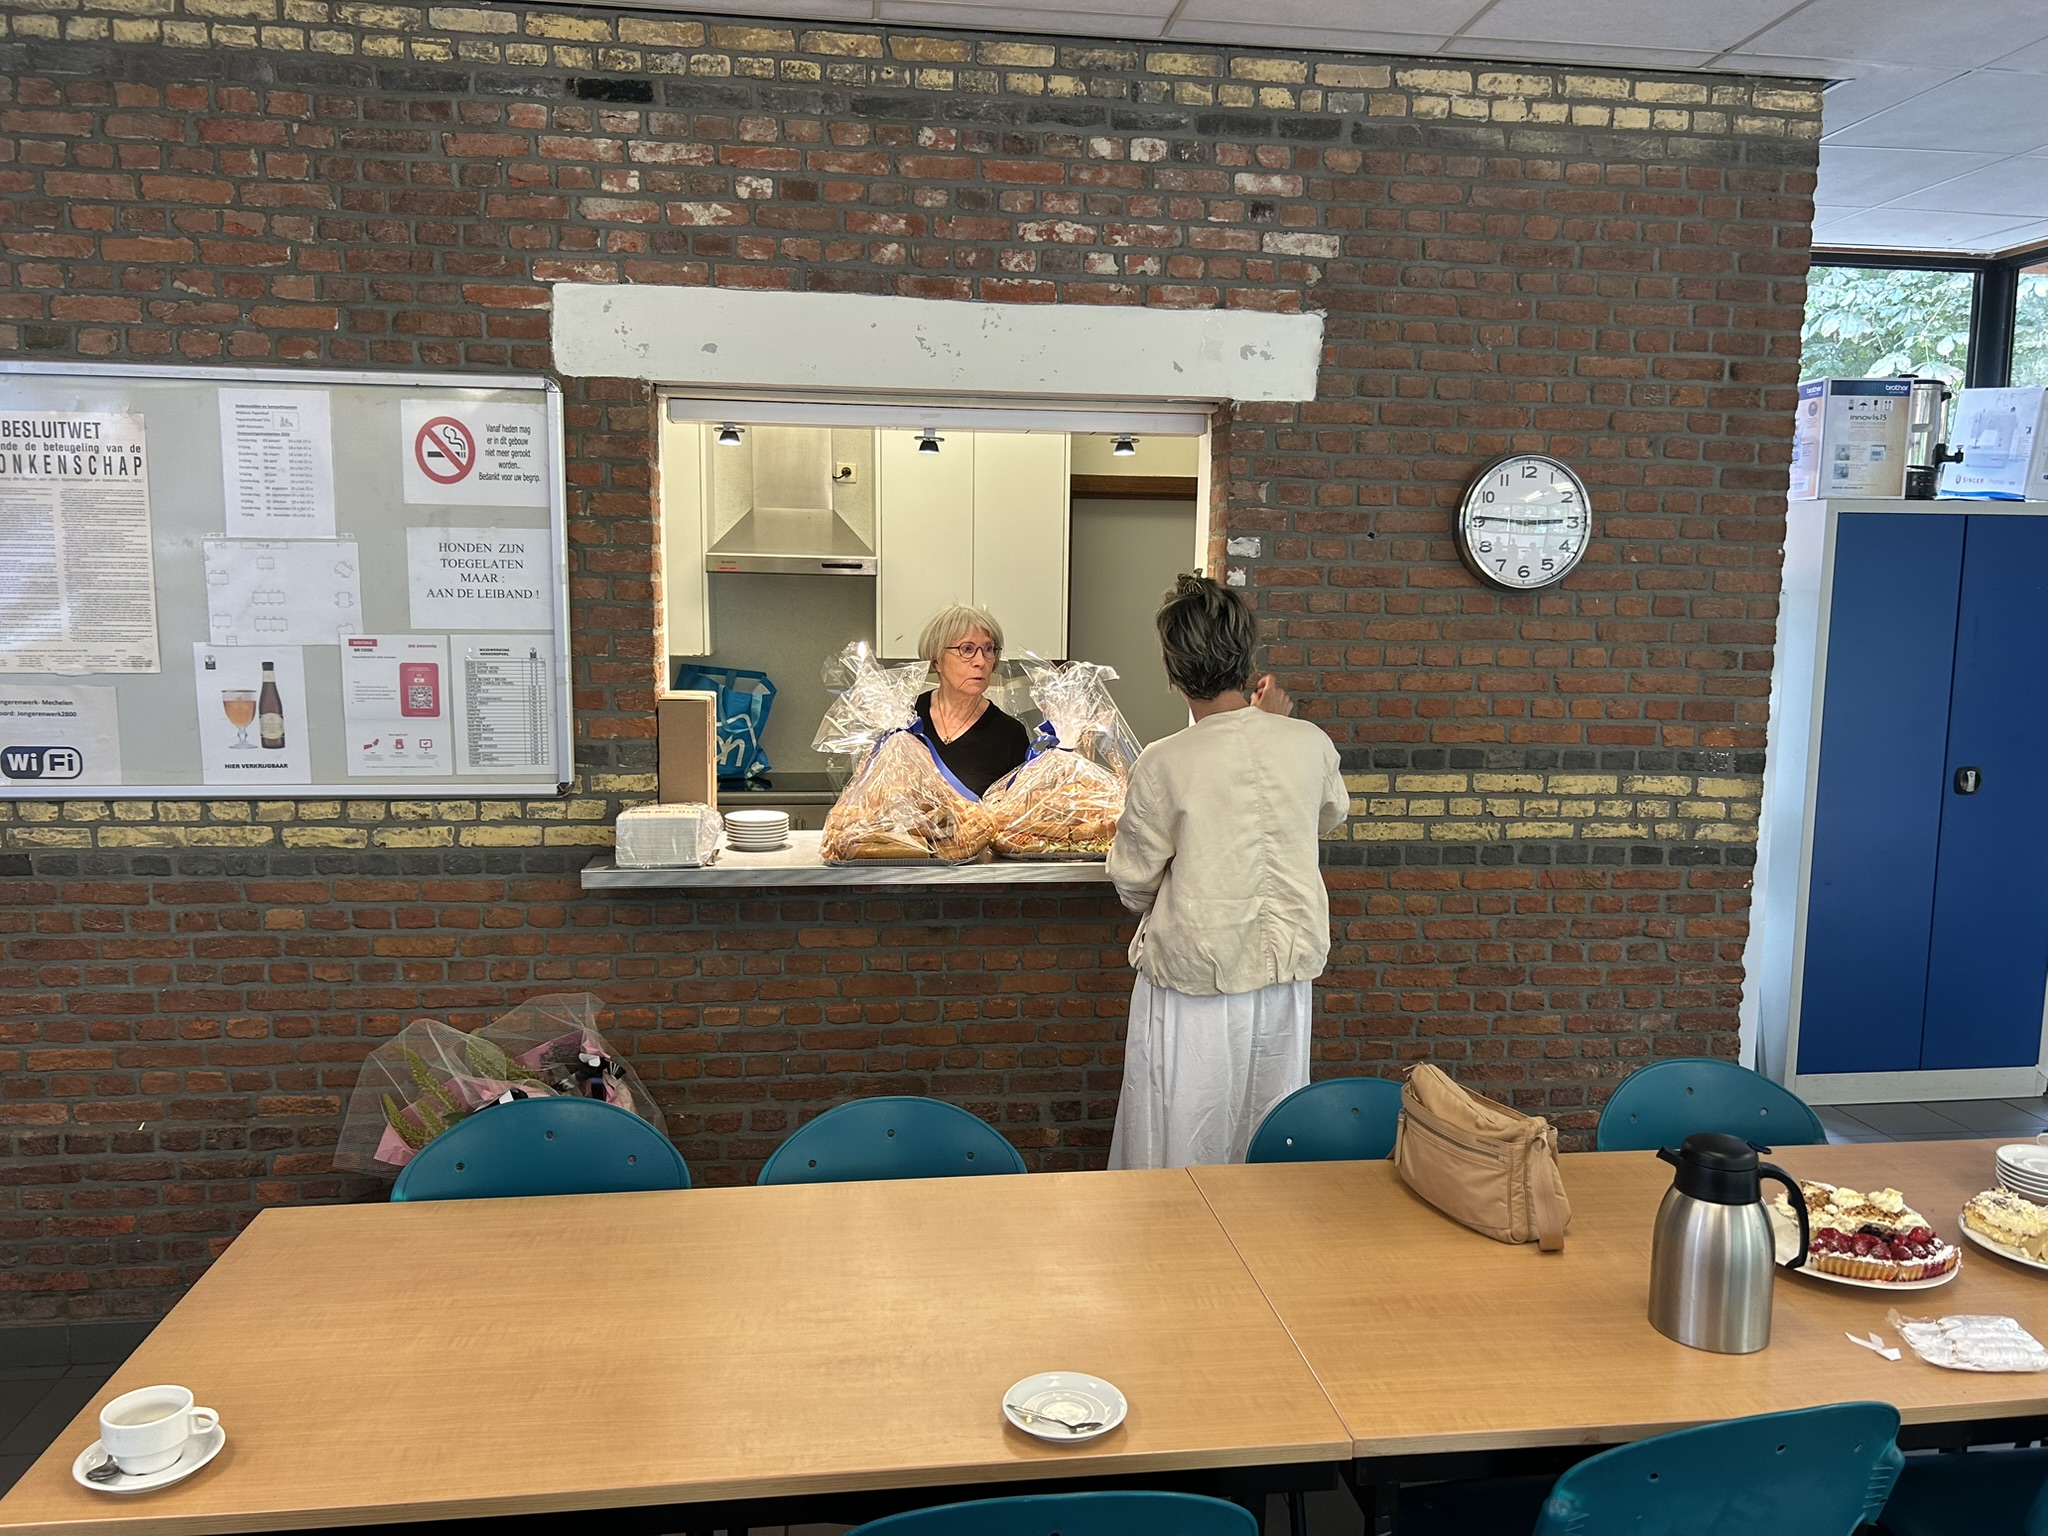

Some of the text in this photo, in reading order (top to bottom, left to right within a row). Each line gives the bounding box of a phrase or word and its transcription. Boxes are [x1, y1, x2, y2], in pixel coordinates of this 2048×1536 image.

[1806, 385, 1822, 394] brother
[1886, 384, 1909, 392] brother
[2, 420, 101, 439] BESLUITWET
[486, 424, 531, 435] Vanaf heden mag
[494, 436, 499, 445] in
[500, 436, 508, 445] dit
[508, 437, 529, 447] gebouw
[0, 442, 141, 454] nde de beteugeling van de
[485, 448, 531, 459] niet meer gerookt
[0, 454, 142, 476] ONKENSCHAP
[479, 472, 500, 481] Bedankt
[523, 474, 541, 484] begrip.
[1521, 466, 1537, 478] 12
[1550, 472, 1554, 484] 1
[1500, 474, 1509, 486] 11
[1482, 491, 1495, 503] 10
[1561, 491, 1573, 503] 2
[1473, 516, 1485, 528] 9
[1566, 516, 1579, 529] 3
[438, 542, 525, 554] HONDEN ZIJN
[1479, 541, 1492, 553] 8
[1559, 540, 1571, 552] 4
[440, 558, 524, 569] TOEGELATEN
[1495, 559, 1506, 572] 7
[1541, 559, 1554, 571] 5
[460, 573, 499, 583] MAAR
[1518, 566, 1530, 578] 6
[426, 588, 454, 598] AAN
[457, 588, 474, 599] DE
[477, 589, 533, 599] LEIBAND
